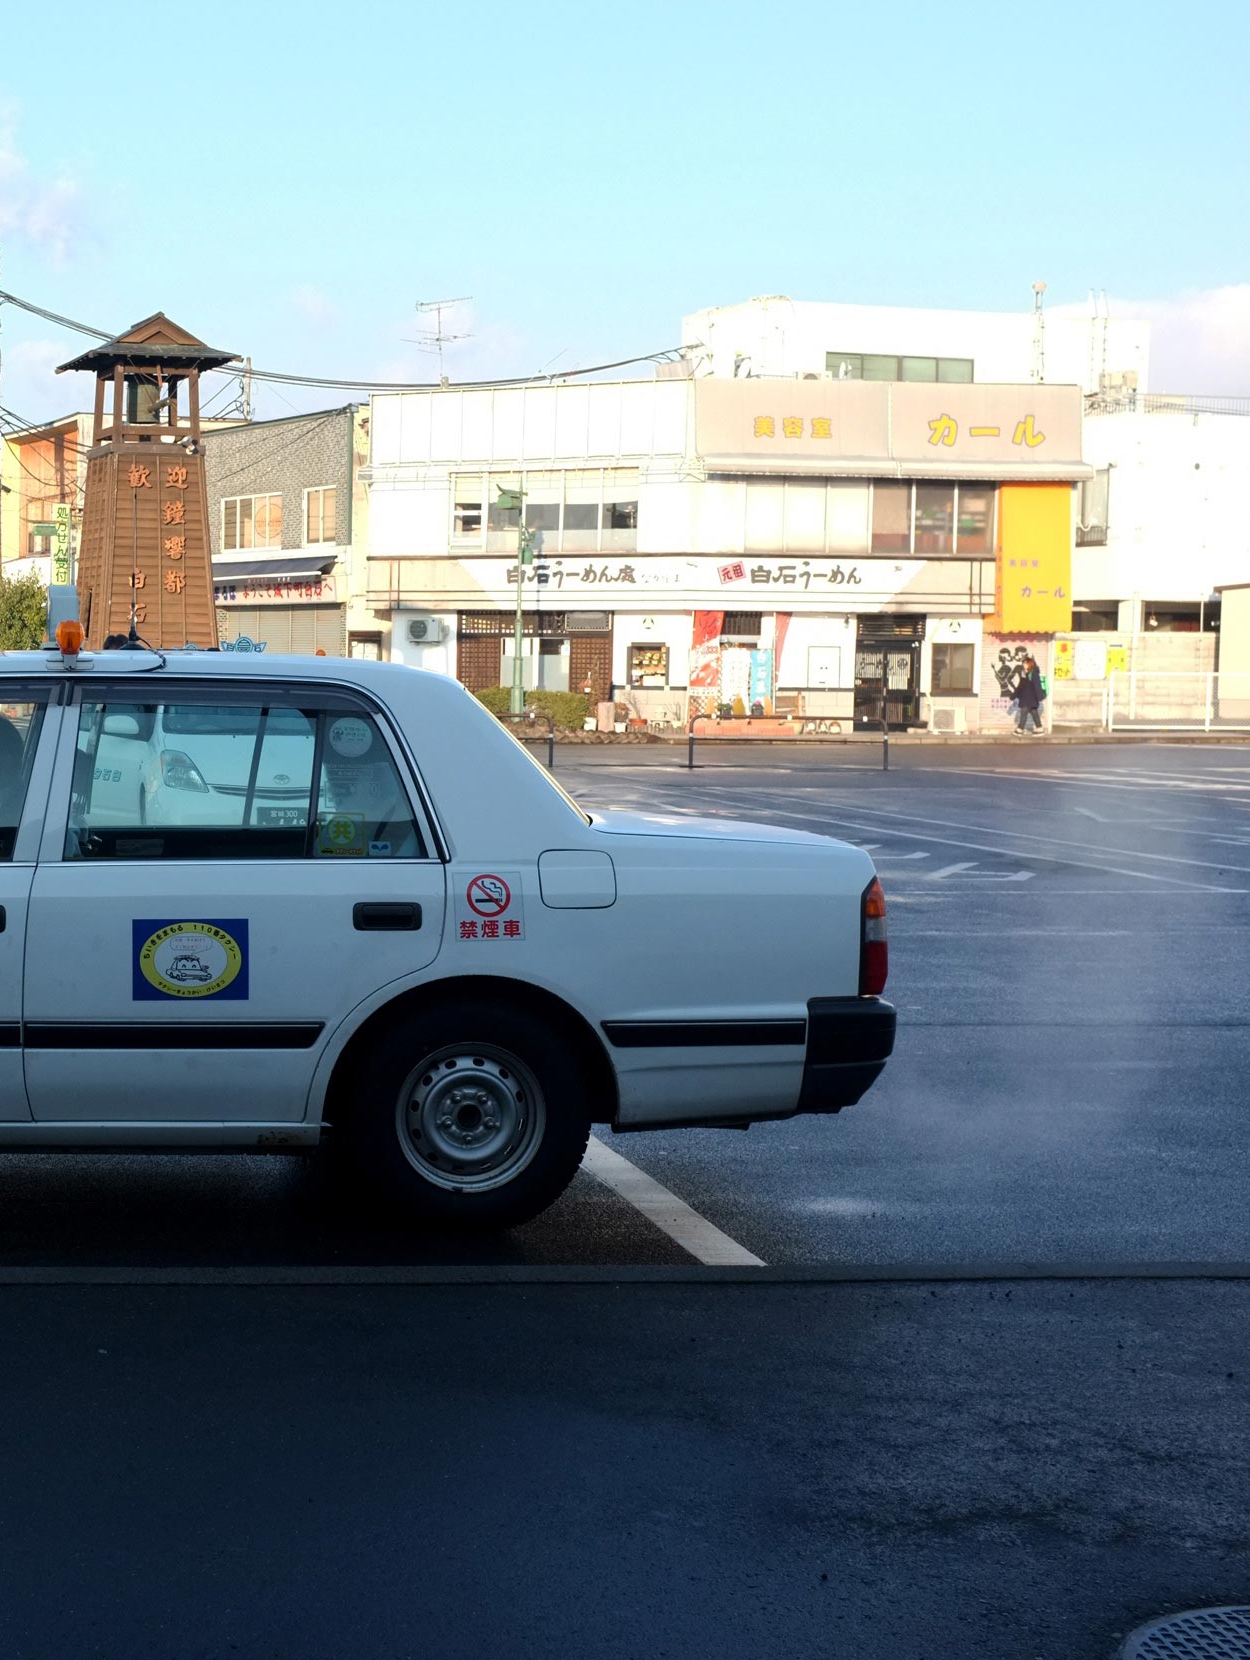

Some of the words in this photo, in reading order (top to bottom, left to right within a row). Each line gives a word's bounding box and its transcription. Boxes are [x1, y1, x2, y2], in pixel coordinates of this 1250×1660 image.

[753, 416, 833, 439] 美容室
[928, 413, 1047, 448] カール
[55, 507, 68, 583] 処方せん受付
[750, 561, 862, 589] 白石うーめん
[1021, 586, 1065, 599] カール
[459, 919, 521, 939] 禁煙車
